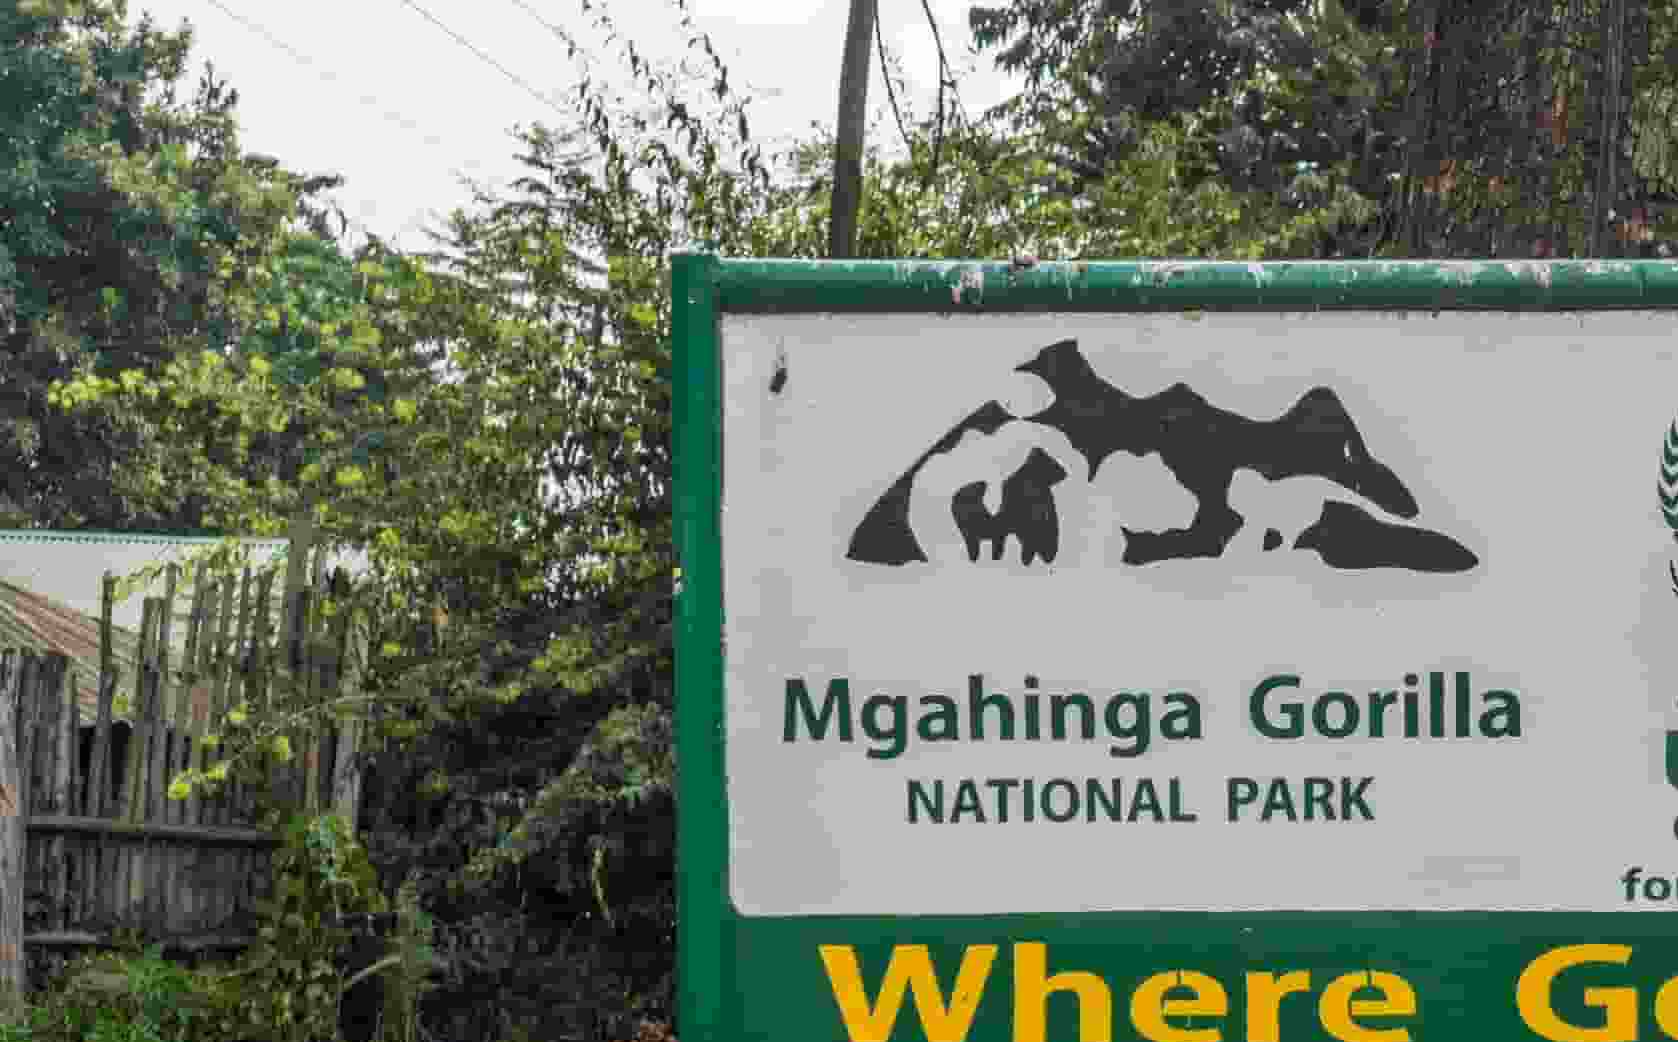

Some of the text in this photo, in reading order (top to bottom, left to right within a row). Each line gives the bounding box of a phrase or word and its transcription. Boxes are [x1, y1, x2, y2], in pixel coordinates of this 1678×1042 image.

[782, 671, 1522, 761] Mgahinga Gorilla
[906, 776, 1376, 825] NATIONAL PARK
